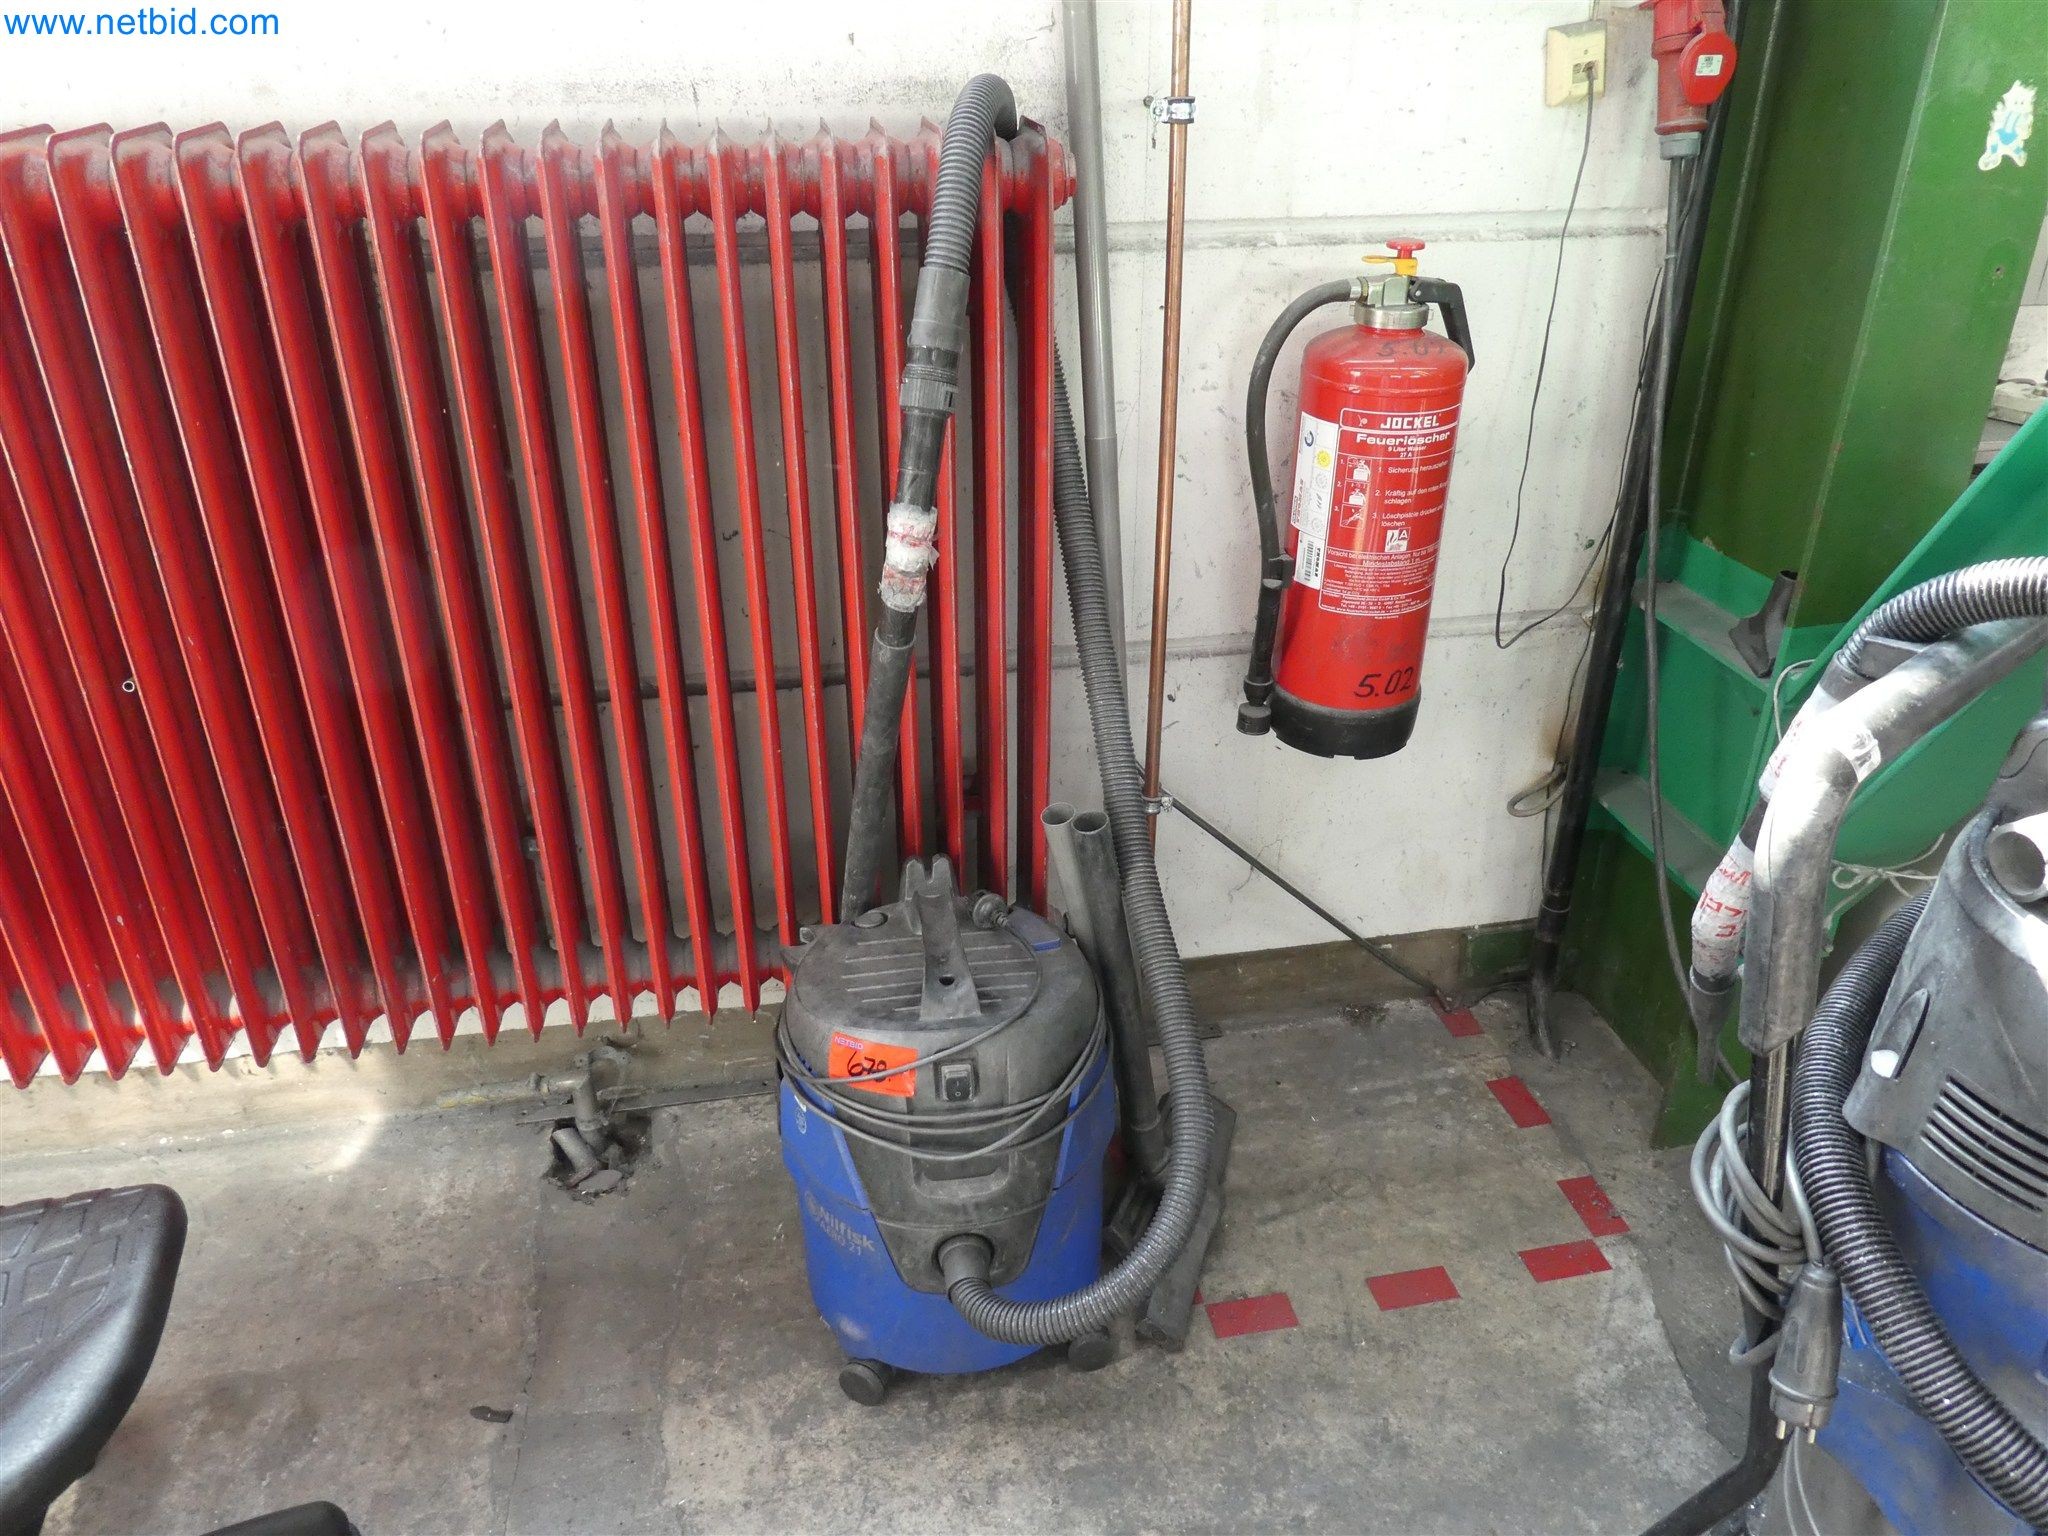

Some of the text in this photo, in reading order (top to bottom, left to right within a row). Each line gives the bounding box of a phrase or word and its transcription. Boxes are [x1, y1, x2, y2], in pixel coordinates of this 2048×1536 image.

[1380, 415, 1440, 429] JOCKEL
[1356, 432, 1450, 445] Feuerlöscher
[1387, 466, 1419, 474] Sicherung
[1400, 529, 1408, 540] A
[1353, 666, 1414, 698] 5.02
[835, 1036, 864, 1050] NETBID
